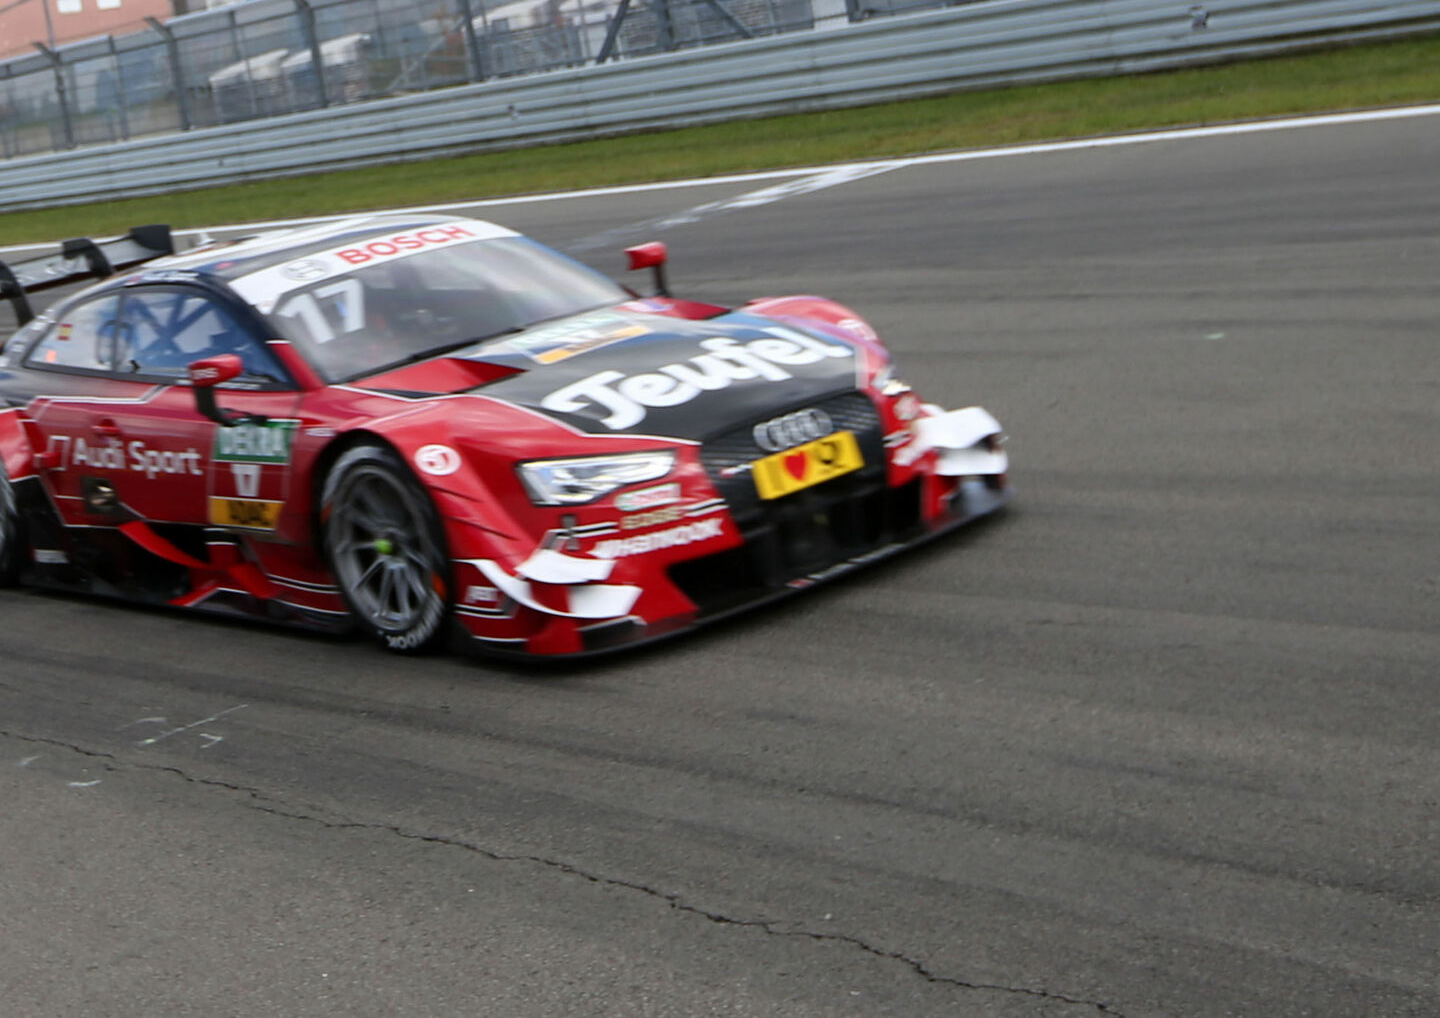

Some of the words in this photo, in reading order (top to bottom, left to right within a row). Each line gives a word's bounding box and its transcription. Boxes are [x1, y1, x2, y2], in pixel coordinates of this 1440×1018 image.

[335, 225, 477, 265] BOSCH
[277, 277, 366, 345] 17
[540, 326, 854, 431] Teufel
[72, 437, 126, 469] Audi
[127, 440, 203, 480] Sport
